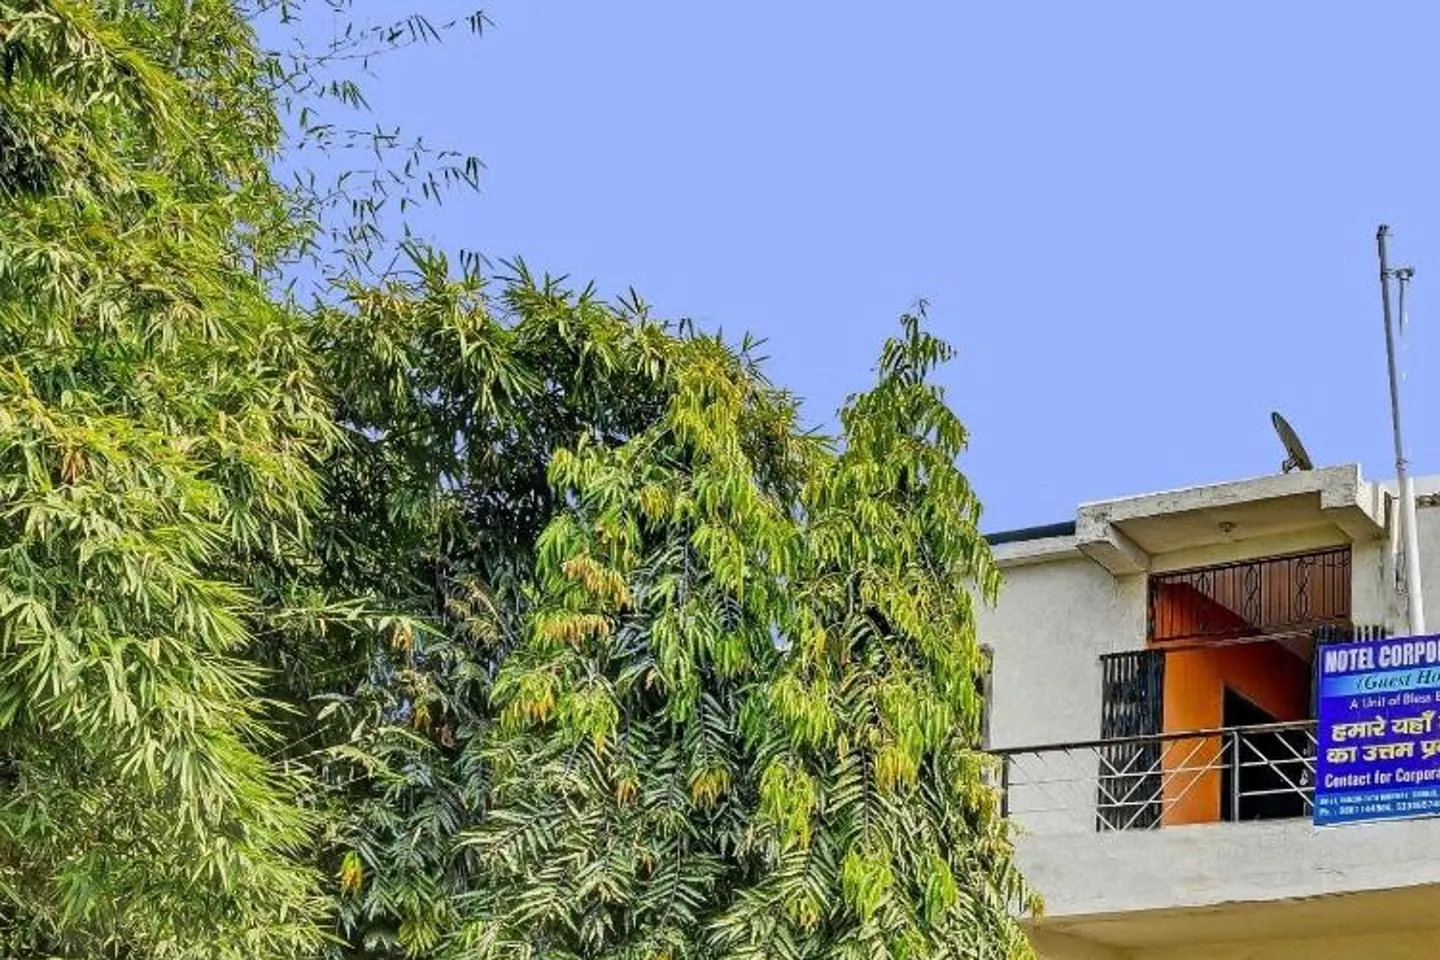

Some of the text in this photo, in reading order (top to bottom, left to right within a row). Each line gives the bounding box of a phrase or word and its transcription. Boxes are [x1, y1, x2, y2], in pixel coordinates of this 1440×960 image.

[1349, 698, 1359, 710] A
[1362, 696, 1385, 708] Unit
[1388, 694, 1400, 706] of
[1331, 715, 1386, 742] हमारे
[1391, 710, 1436, 734] यहाँ
[1326, 746, 1358, 764] का
[1362, 742, 1415, 762] उत्तम
[1324, 769, 1371, 788] Contact
[1374, 769, 1393, 784] for
